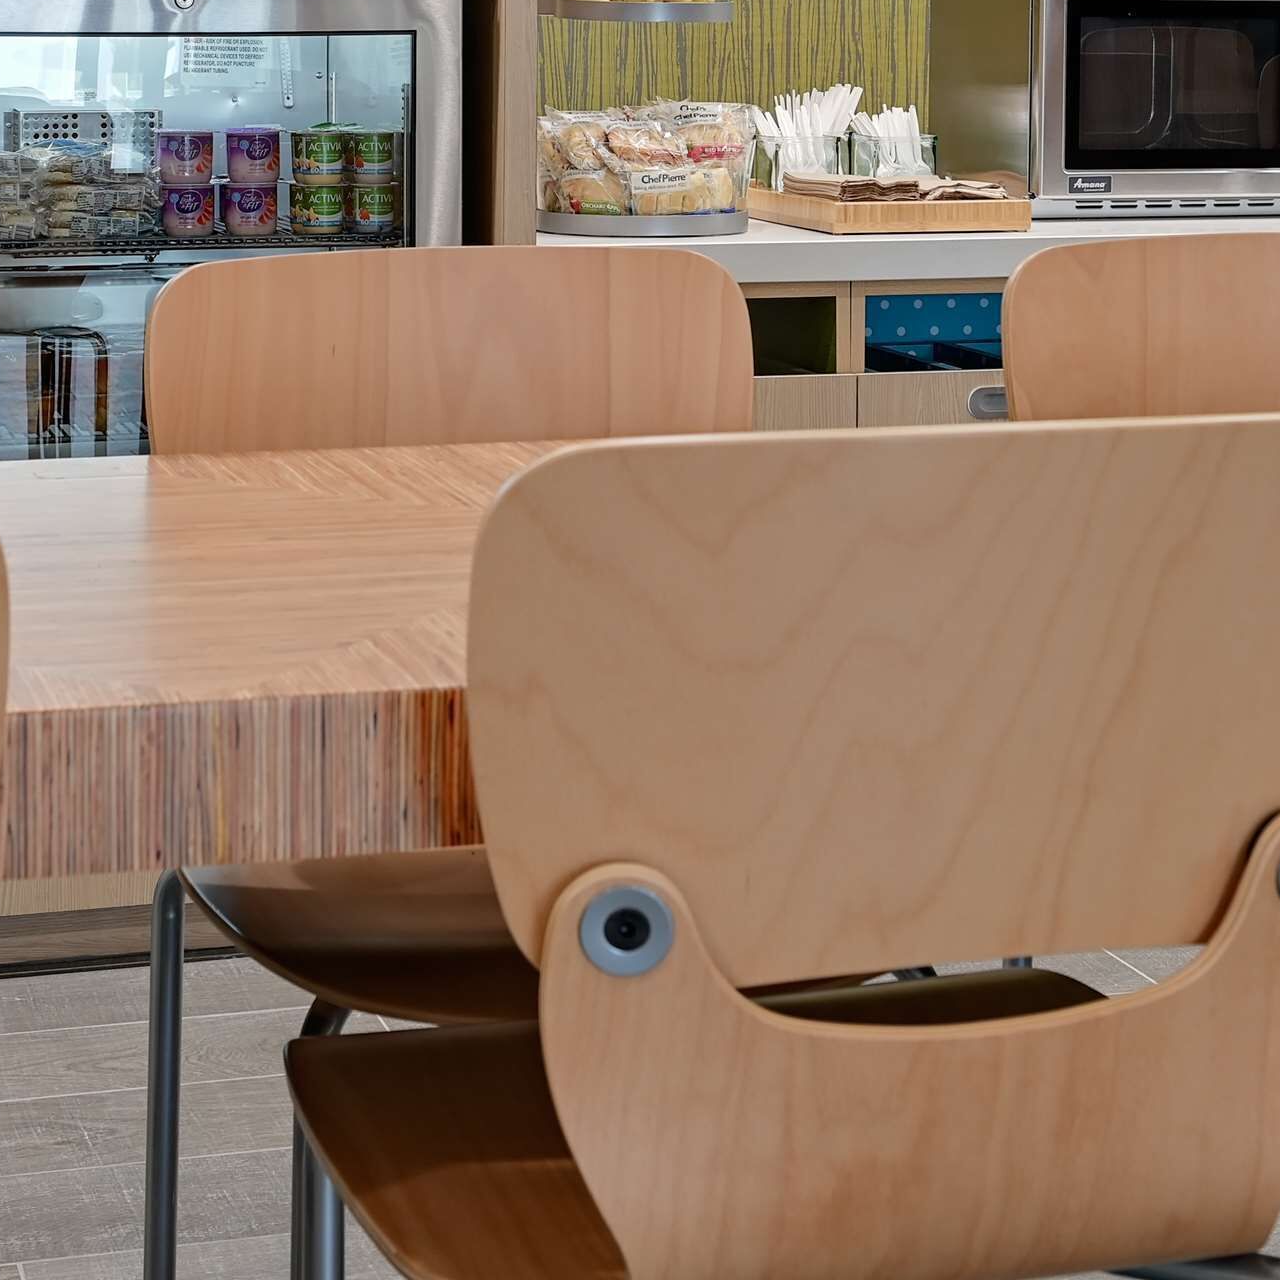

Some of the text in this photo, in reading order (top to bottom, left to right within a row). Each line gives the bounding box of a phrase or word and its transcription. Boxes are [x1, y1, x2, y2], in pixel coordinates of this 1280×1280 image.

[641, 173, 686, 184] Chef Pierre
[1073, 178, 1107, 189] Amana
